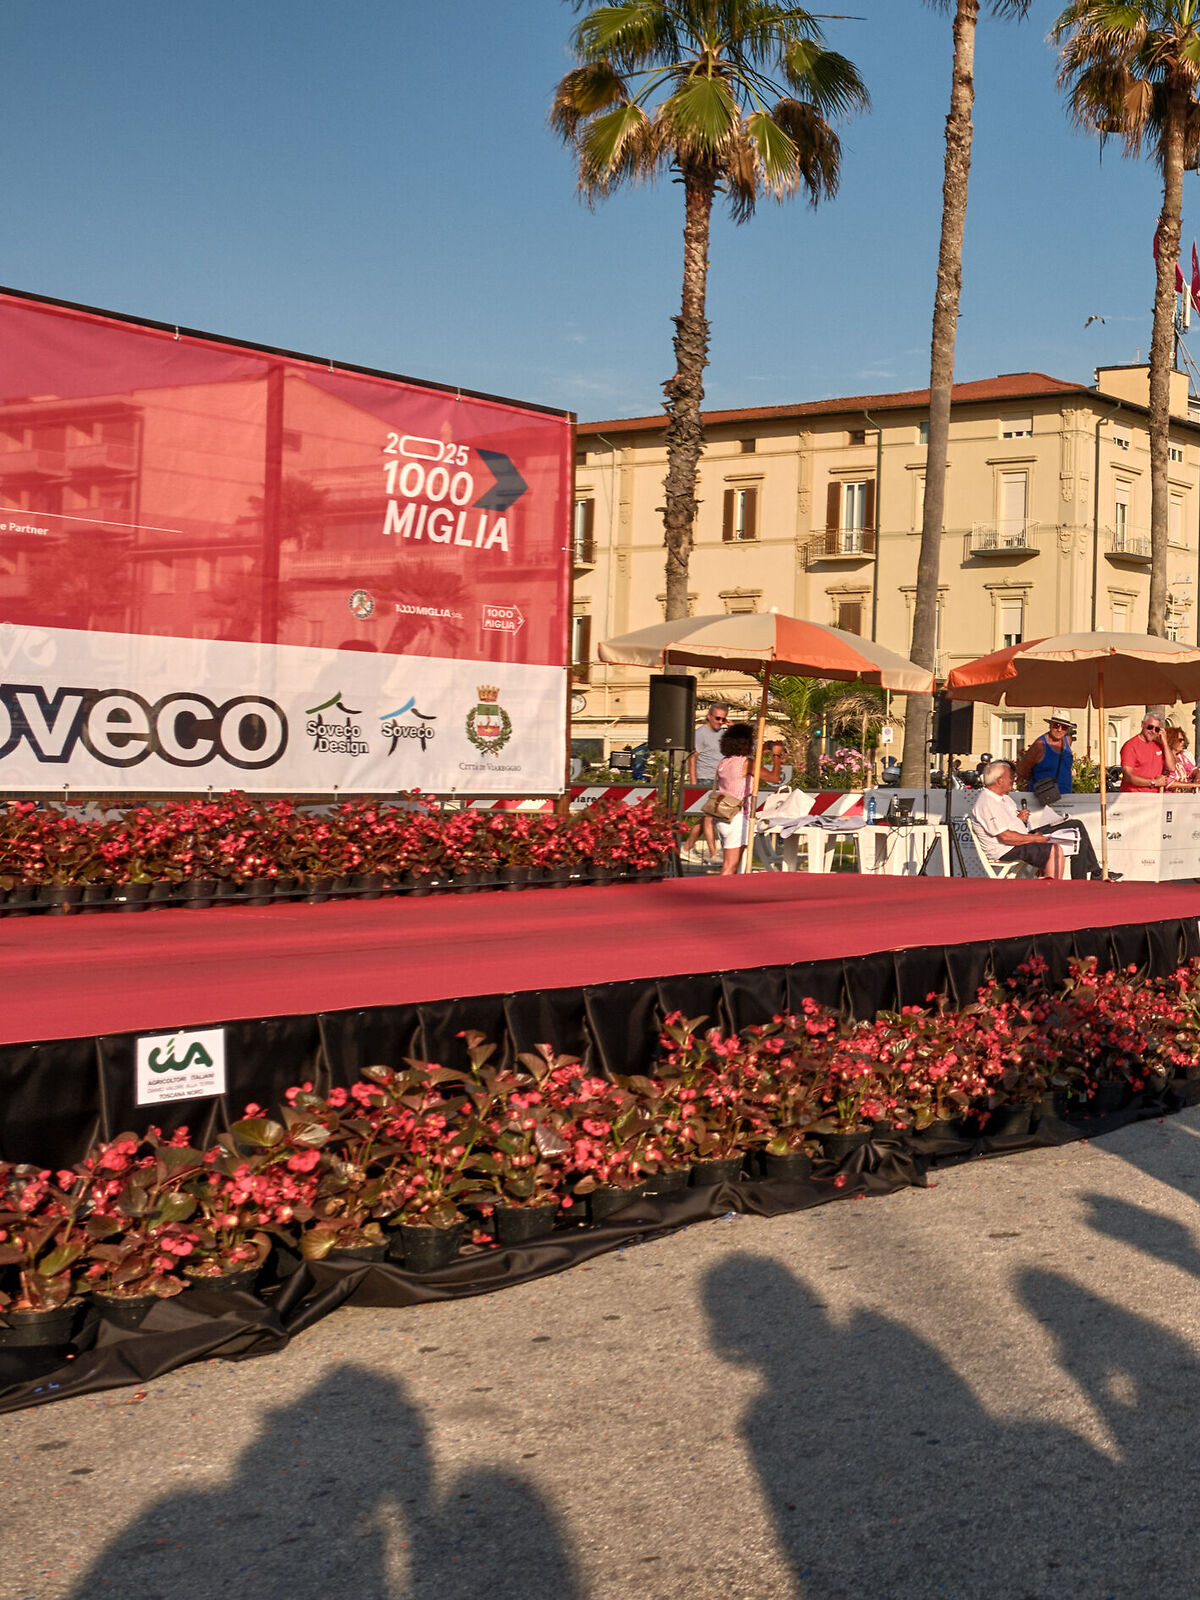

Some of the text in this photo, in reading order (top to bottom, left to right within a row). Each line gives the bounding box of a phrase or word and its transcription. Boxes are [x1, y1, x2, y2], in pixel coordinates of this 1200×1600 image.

[383, 460, 474, 506] 1000
[9, 522, 49, 535] Partner
[382, 500, 509, 552] MIGLIA
[487, 609, 514, 619] 1000
[485, 619, 515, 629] MIGLIA
[0, 683, 289, 770] veco
[306, 720, 361, 738] Soveco
[381, 723, 434, 740] Soveco
[318, 738, 369, 756] Design
